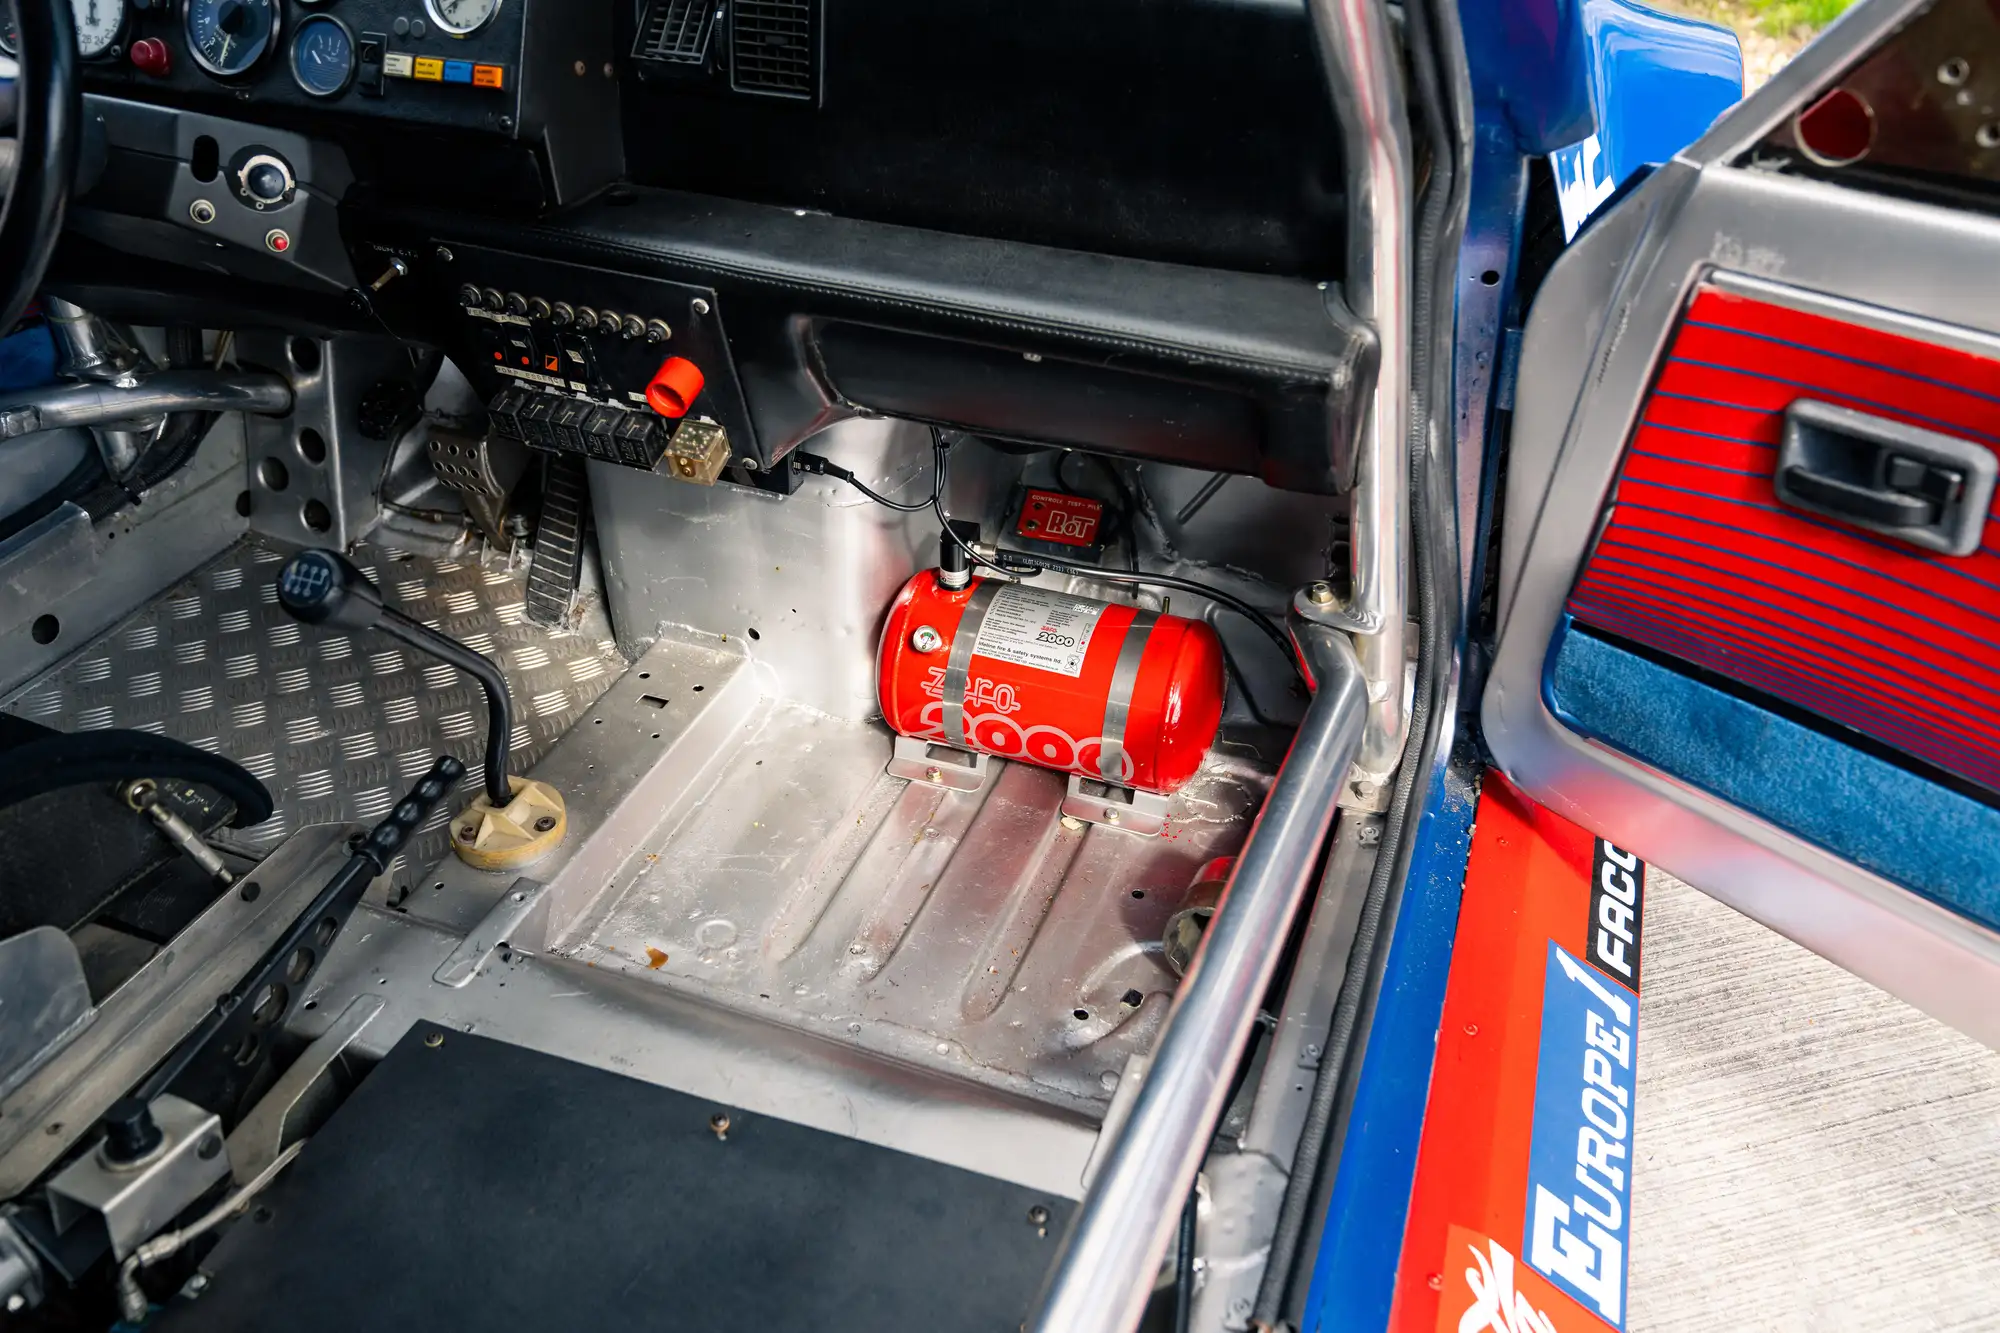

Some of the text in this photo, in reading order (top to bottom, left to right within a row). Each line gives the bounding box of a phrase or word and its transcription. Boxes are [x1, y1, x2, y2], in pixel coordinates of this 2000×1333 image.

[1035, 631, 1075, 648] 2000
[1012, 649, 1029, 657] safety
[1030, 653, 1053, 662] systems
